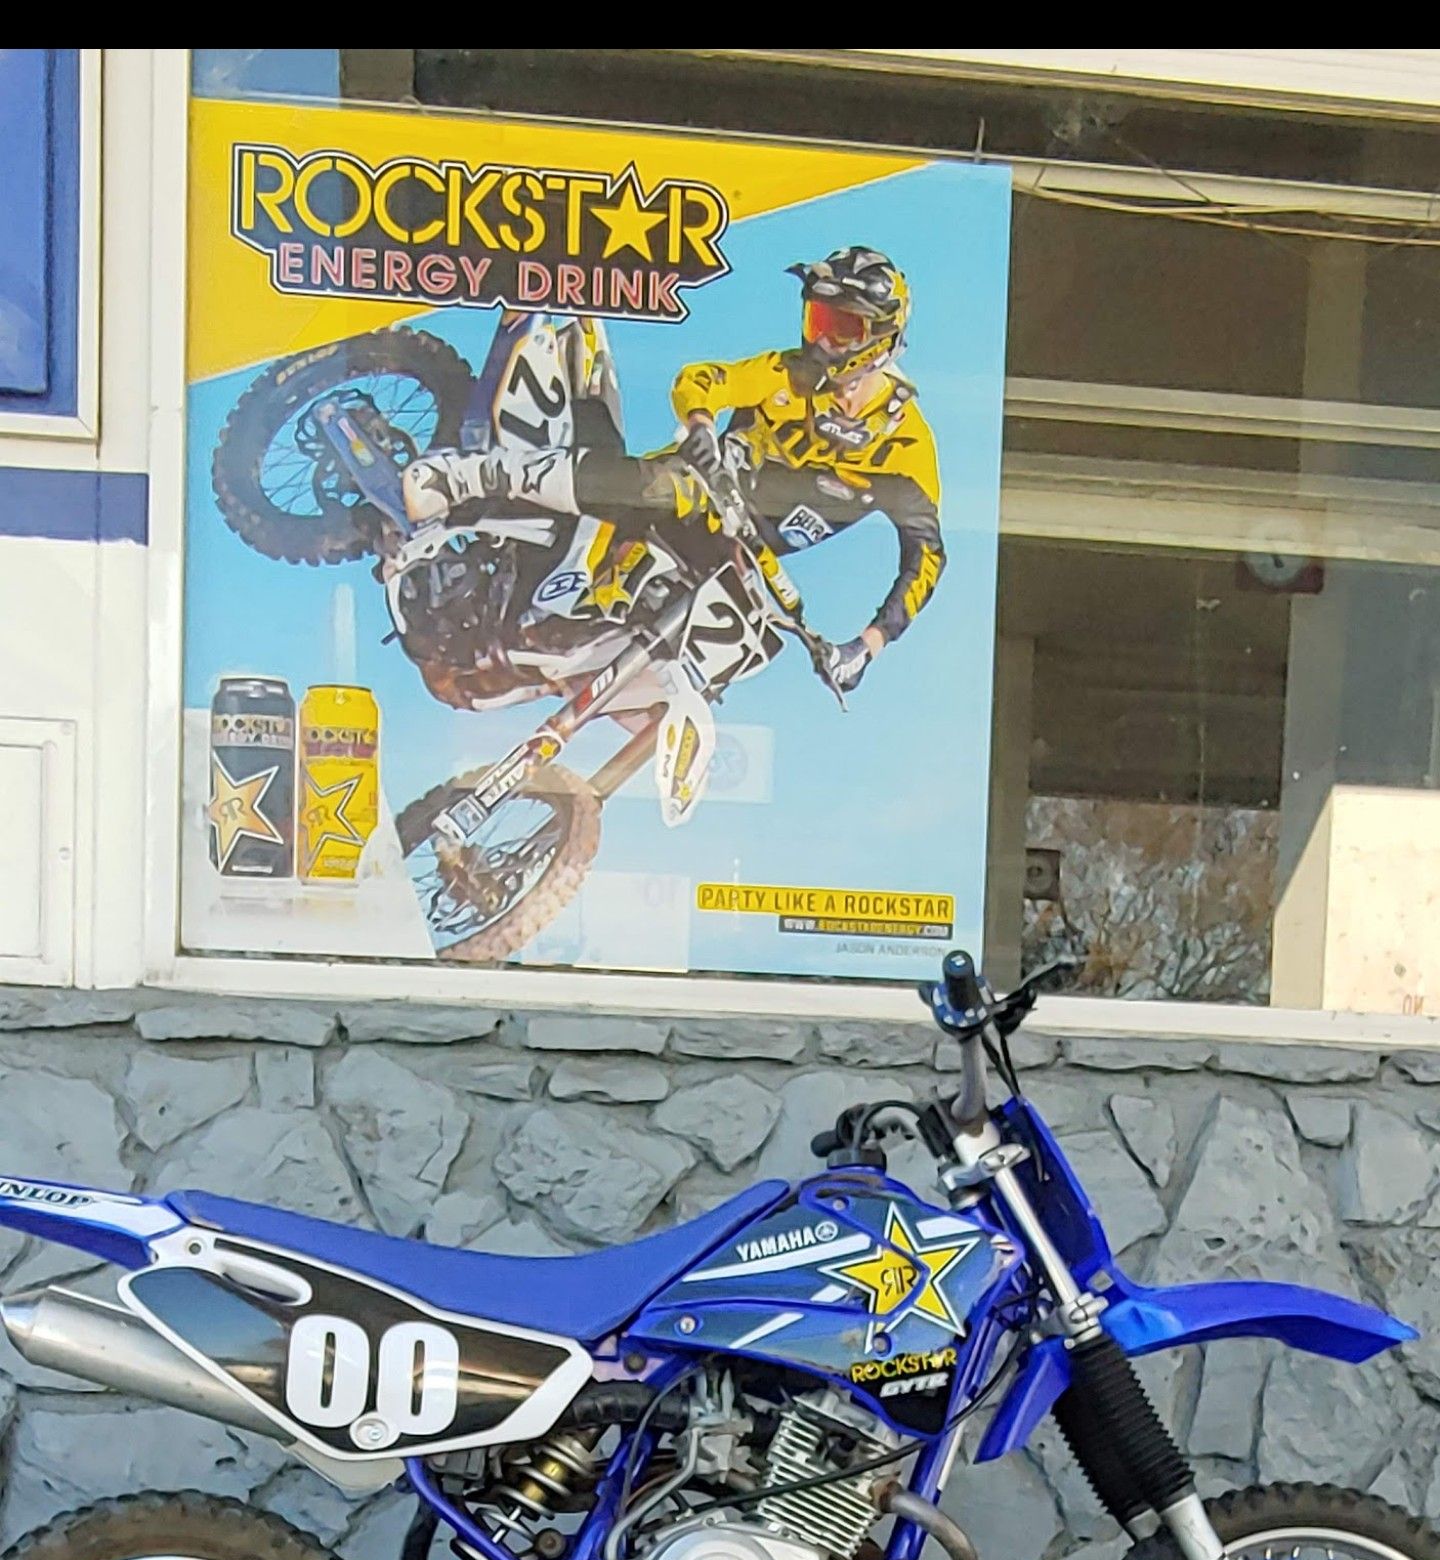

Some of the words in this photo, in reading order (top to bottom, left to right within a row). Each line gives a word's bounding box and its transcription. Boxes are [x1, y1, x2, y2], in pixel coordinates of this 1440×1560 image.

[241, 151, 721, 267] ROCKSTAR
[279, 243, 492, 298] ENERGY
[517, 261, 686, 313] DRINK
[701, 887, 766, 909] PARTY
[774, 890, 817, 912] LIKE
[824, 894, 837, 913] A
[844, 895, 949, 918] ROCKSTAR
[736, 1226, 817, 1262] YAMAHA
[286, 1314, 460, 1435] 00
[851, 1347, 958, 1384] ROCKSTAR
